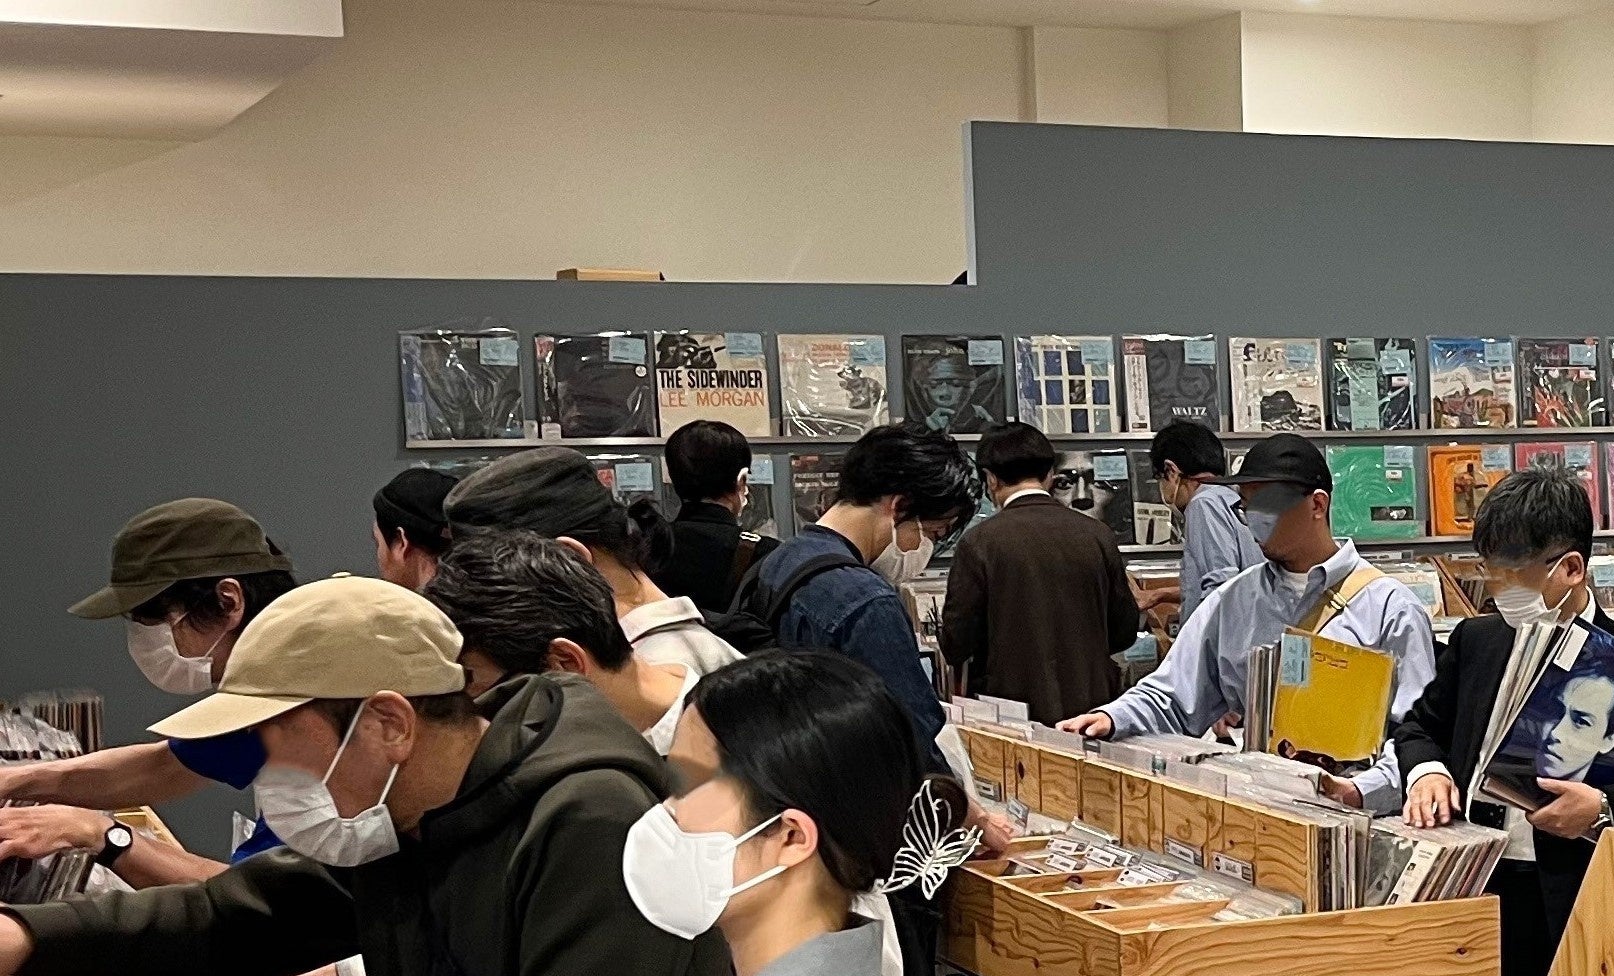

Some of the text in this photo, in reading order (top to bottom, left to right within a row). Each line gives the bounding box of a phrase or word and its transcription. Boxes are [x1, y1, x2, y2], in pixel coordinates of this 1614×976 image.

[660, 369, 763, 389] THE SIDEWINDER
[661, 391, 765, 407] LEE MORGAN
